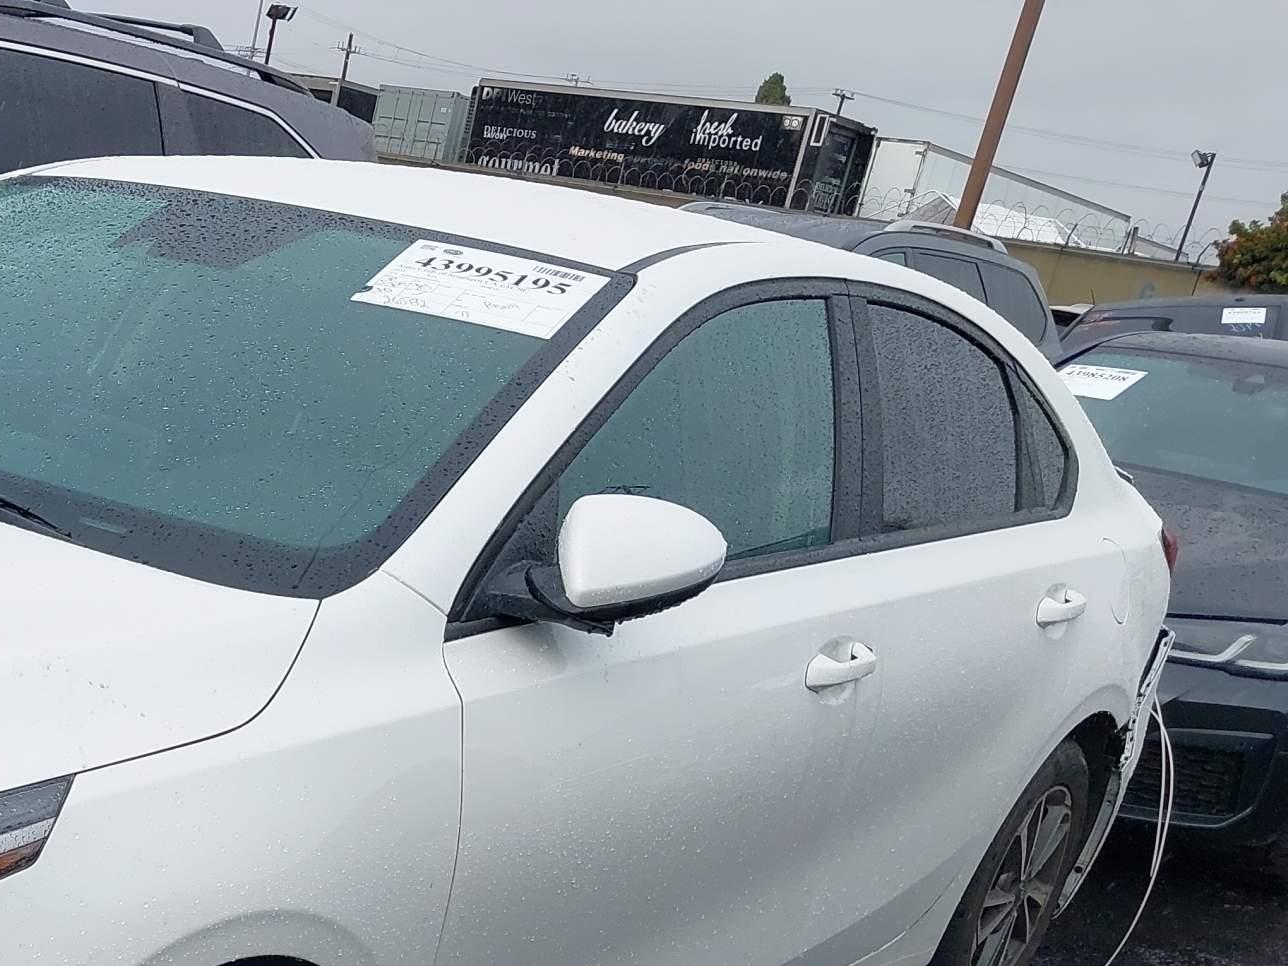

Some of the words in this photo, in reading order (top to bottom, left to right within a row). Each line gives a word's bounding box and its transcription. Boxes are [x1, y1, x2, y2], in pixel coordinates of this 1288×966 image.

[507, 88, 537, 106] West
[483, 125, 537, 139] DELICIOUS
[602, 108, 666, 147] bakery
[695, 108, 739, 138] fresh
[689, 128, 762, 152] imported
[568, 145, 625, 163] Marketing
[415, 255, 574, 296] 43995195
